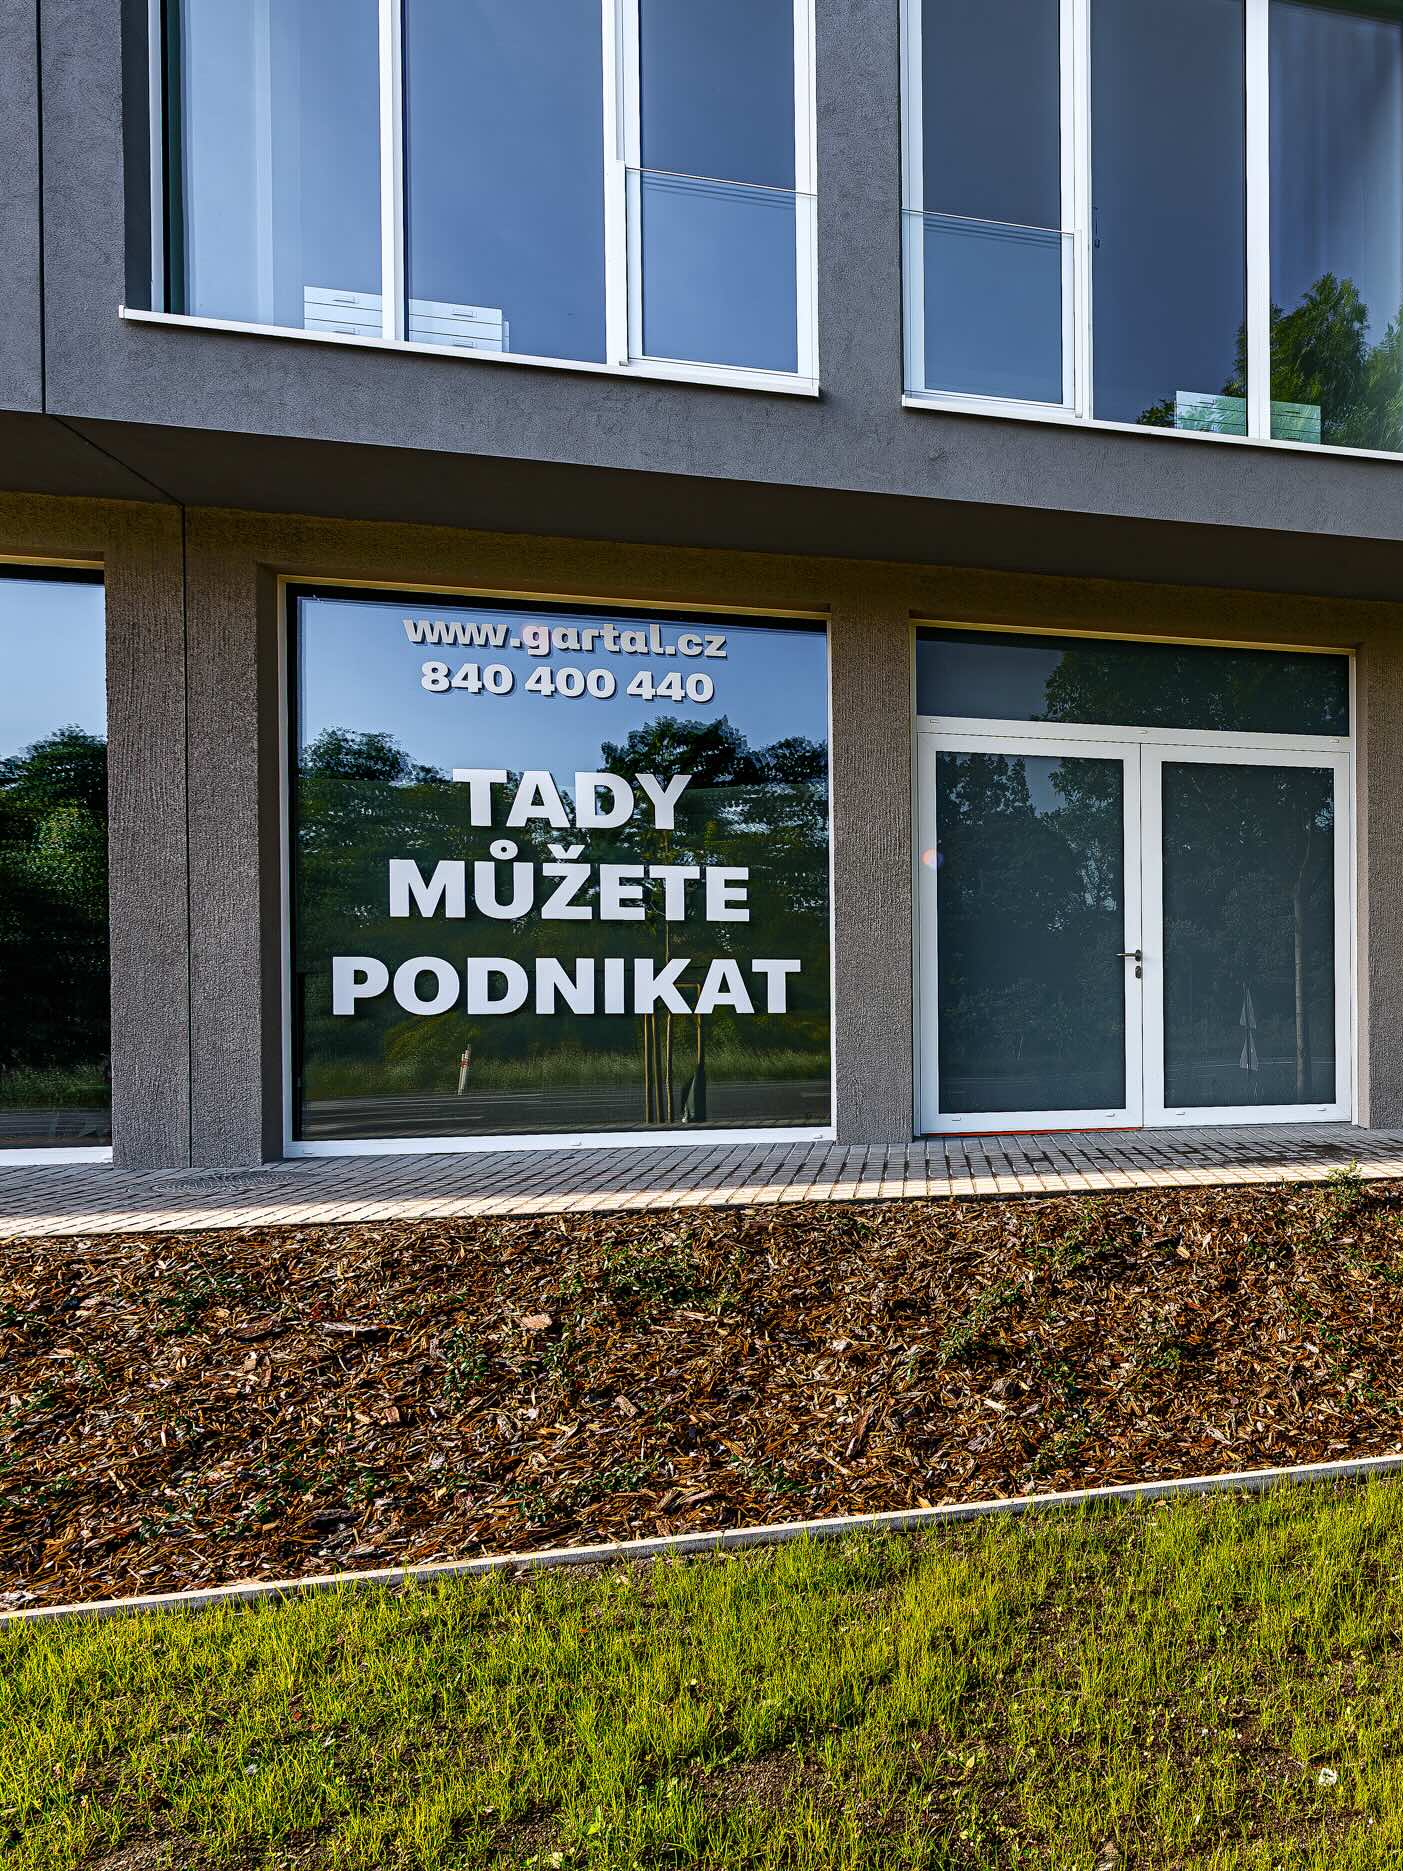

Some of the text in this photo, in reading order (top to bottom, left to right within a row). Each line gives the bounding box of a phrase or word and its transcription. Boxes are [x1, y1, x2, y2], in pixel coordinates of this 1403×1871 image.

[403, 617, 728, 658] www.gartal.cz
[421, 661, 715, 703] 840 400 440
[452, 768, 693, 831] TADY
[389, 839, 751, 922] MŮŽETE
[332, 956, 801, 1016] PODNIKAT
